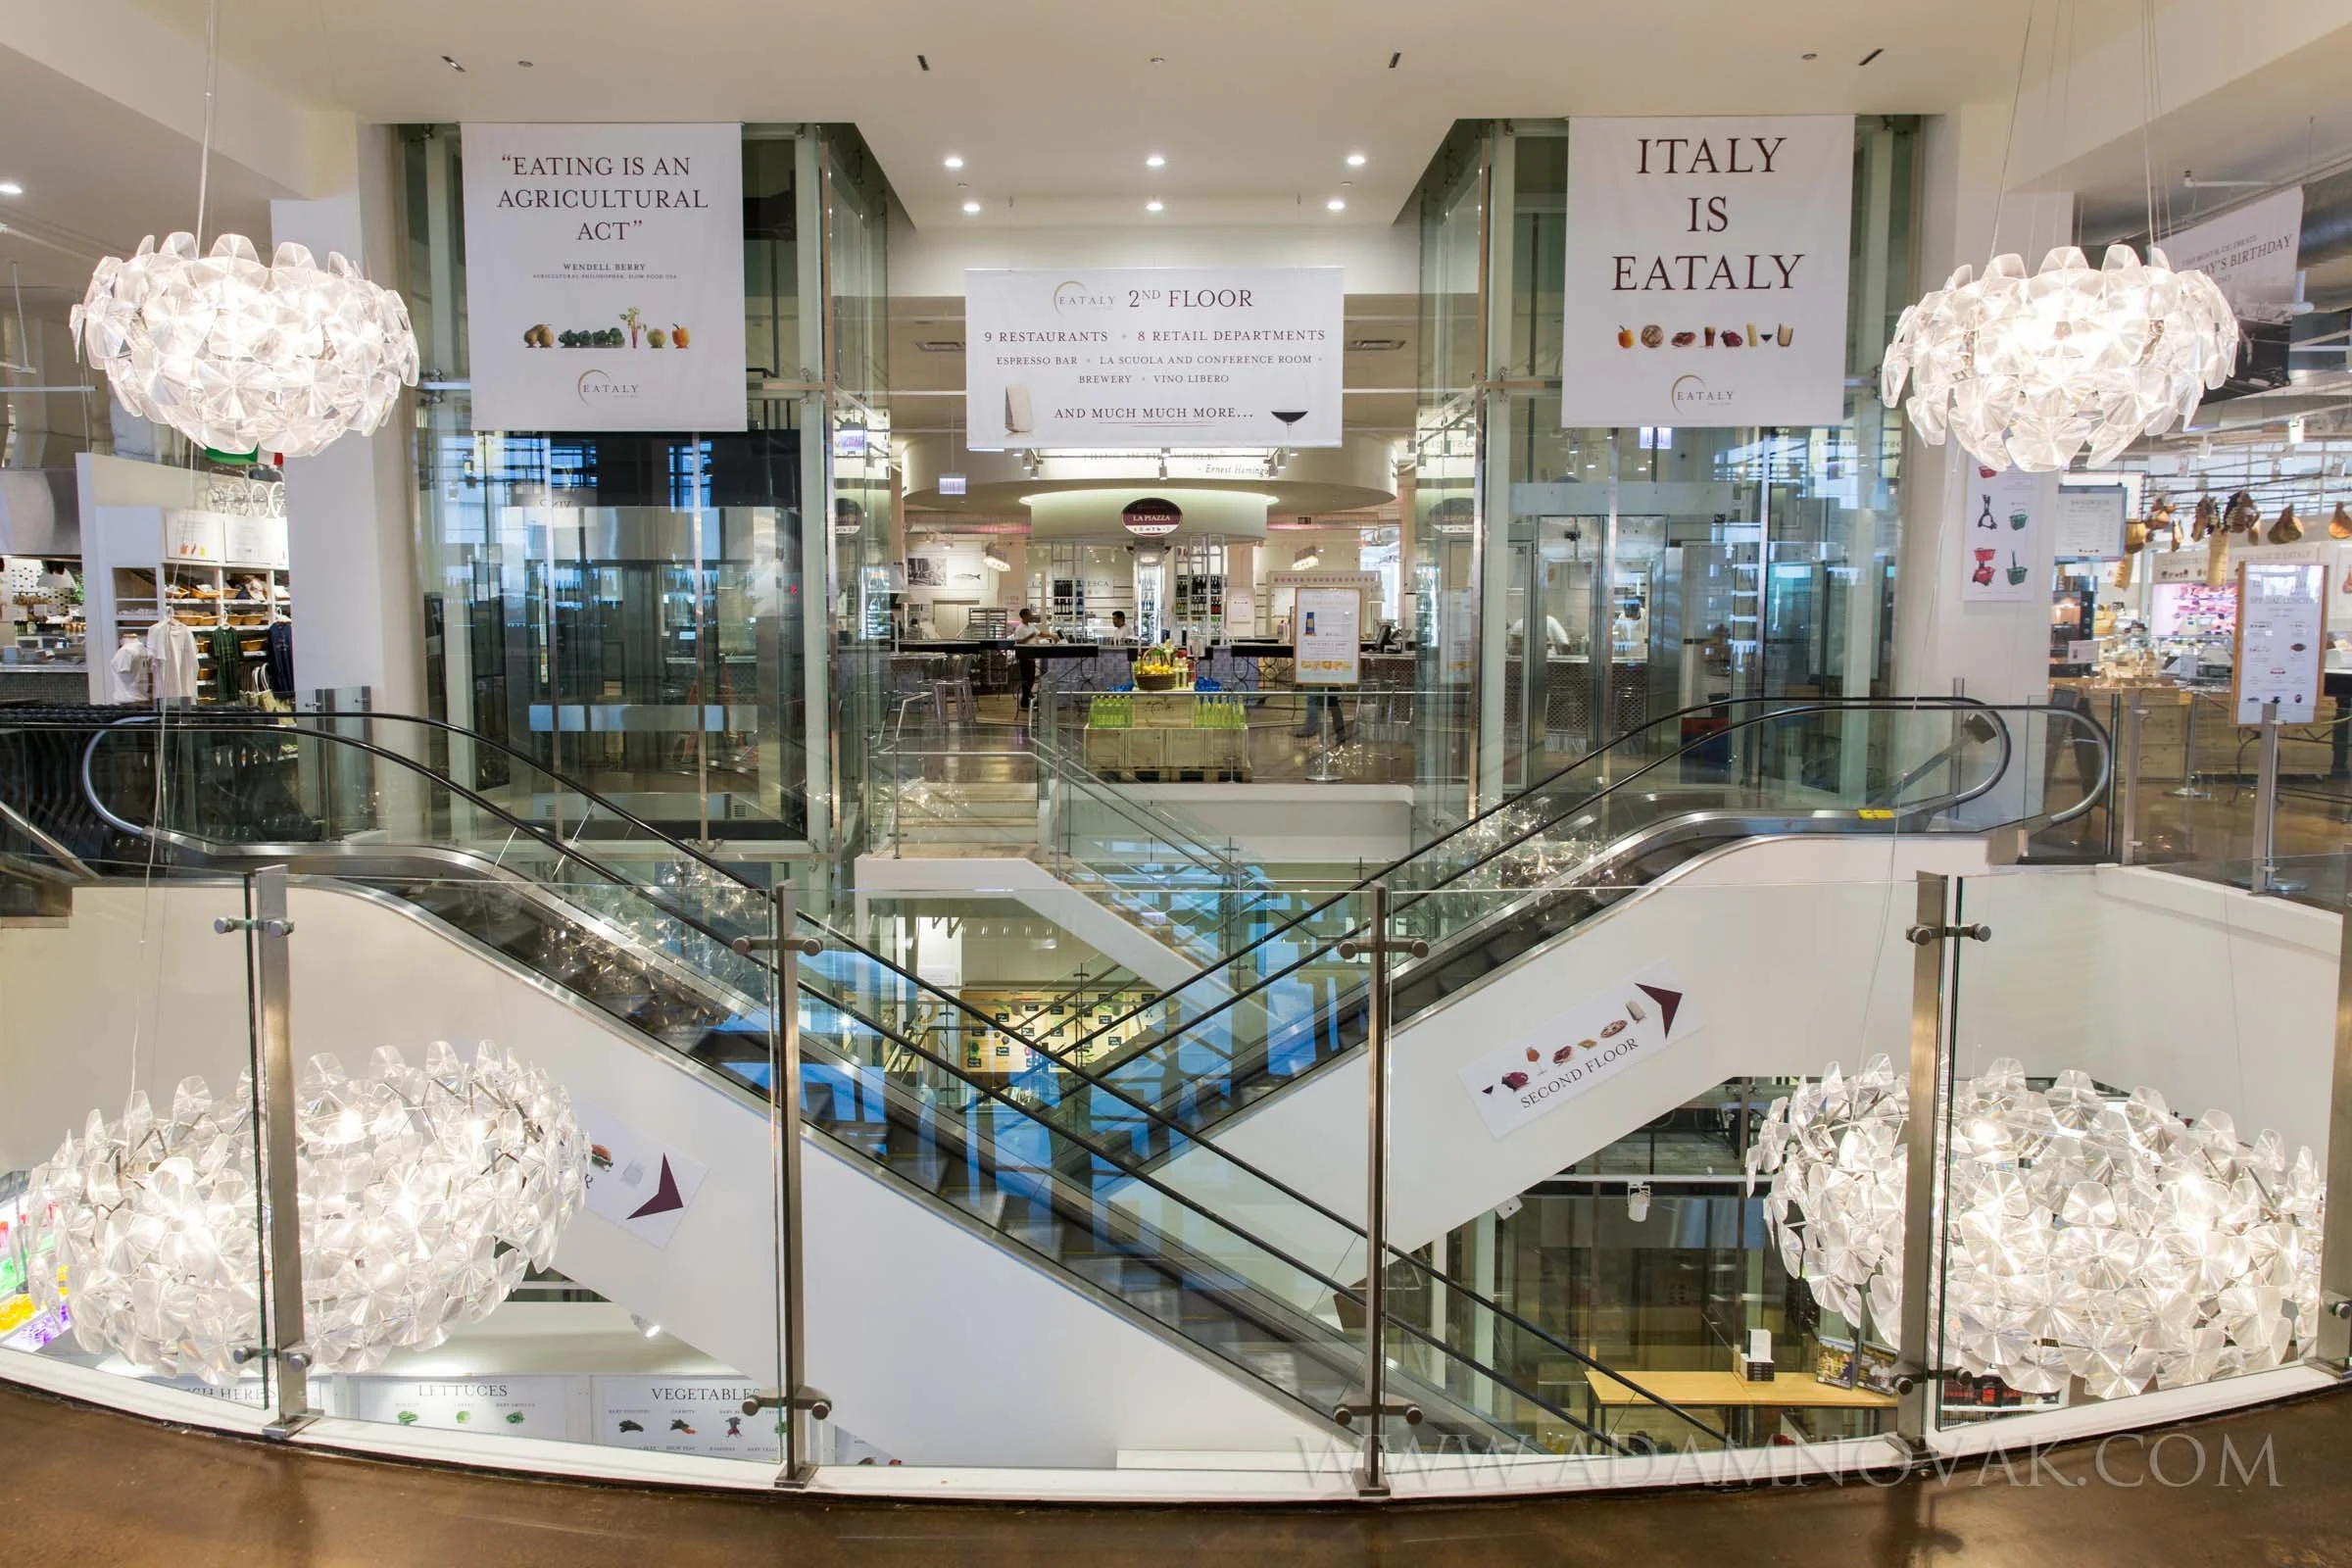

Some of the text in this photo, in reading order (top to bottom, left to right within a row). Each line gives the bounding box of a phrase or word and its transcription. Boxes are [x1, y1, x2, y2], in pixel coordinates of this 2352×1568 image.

[501, 154, 690, 176] “EATING IS AN
[1636, 136, 1788, 174] ITALY
[496, 188, 709, 209] AGRICULTURAL
[1686, 195, 1729, 233] IS
[576, 219, 643, 241] ACT”
[2230, 233, 2294, 268] BIRTHDAY
[563, 262, 647, 271] WENDELL BERRY
[1611, 253, 1806, 292] EATALY
[1057, 288, 1254, 309] EATALY 2ND FLOOR
[984, 328, 1326, 343] 9 RESTAURANTS 8 RETAIL DEPARTMENTS
[996, 354, 1312, 367] ESPRESSO BAR LA SCUOLA AND CONFERENCE ROOM
[582, 383, 639, 394] EATALY
[1078, 373, 1230, 385] BREWERY VINO LIBERO
[1676, 390, 1735, 402] EATALY
[1054, 407, 1254, 419] AND MUCH MUCH MORE...
[1521, 1039, 1639, 1109] SECOND FLOOR
[417, 1384, 509, 1397] LETTUCES
